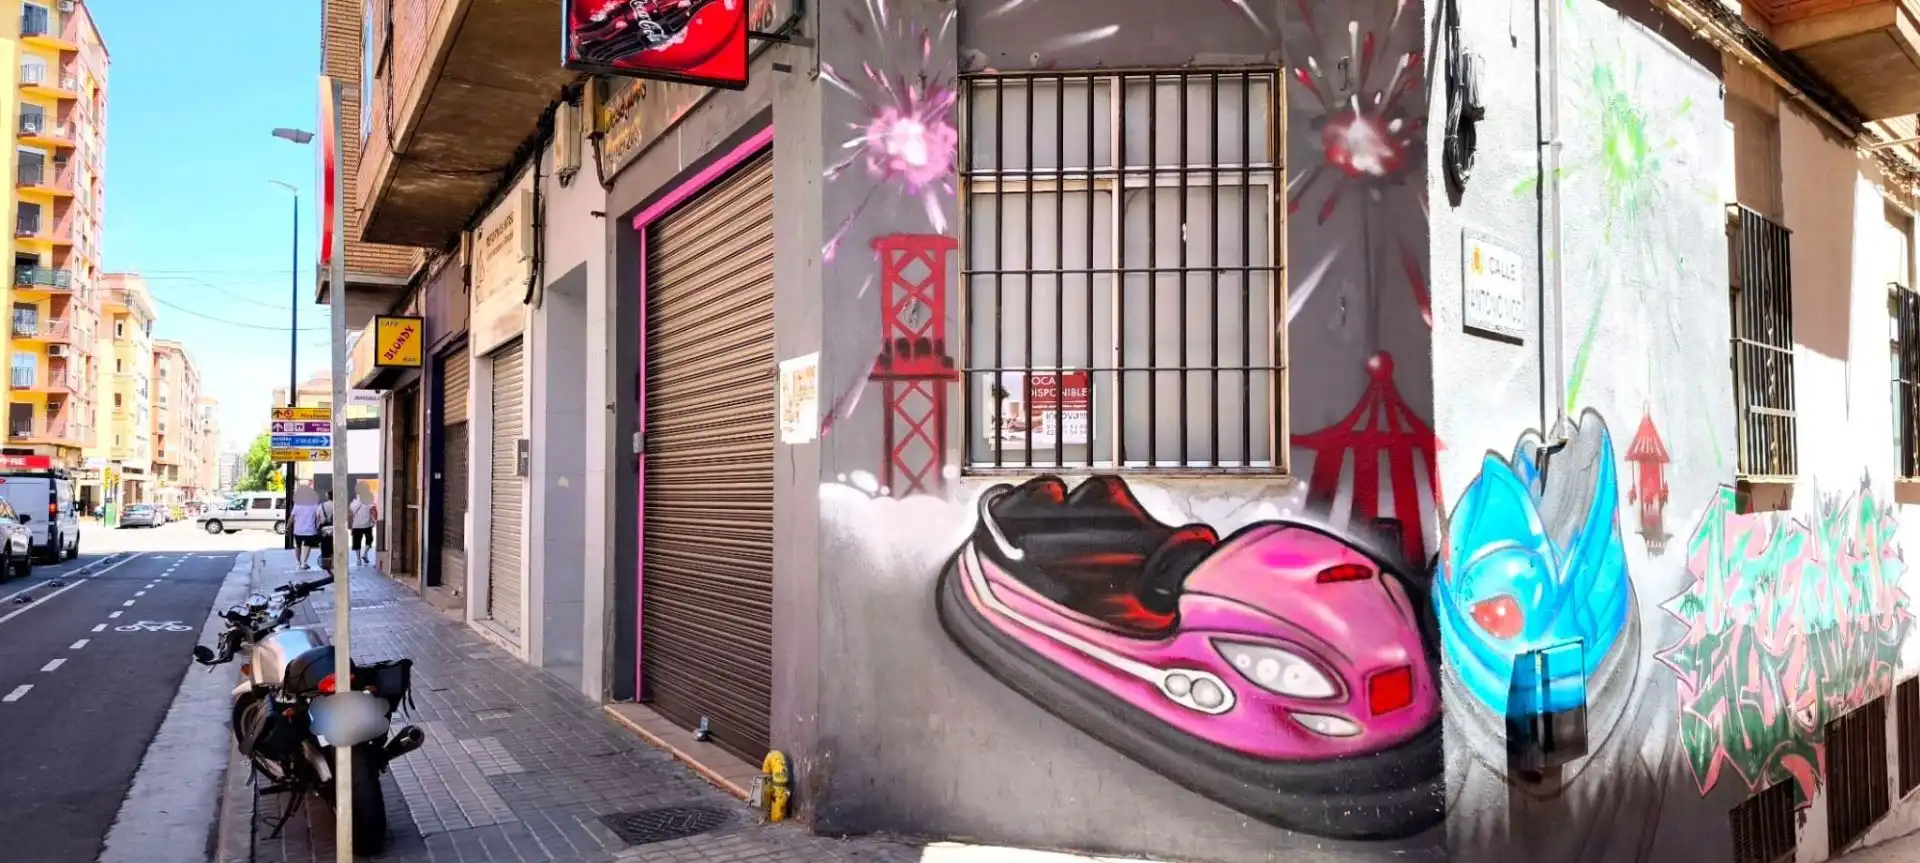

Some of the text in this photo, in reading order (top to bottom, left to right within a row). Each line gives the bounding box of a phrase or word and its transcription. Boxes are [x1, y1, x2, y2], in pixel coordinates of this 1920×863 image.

[1489, 256, 1516, 281] CALLE
[384, 325, 414, 360] BLONDY
[1031, 376, 1056, 386] OCA
